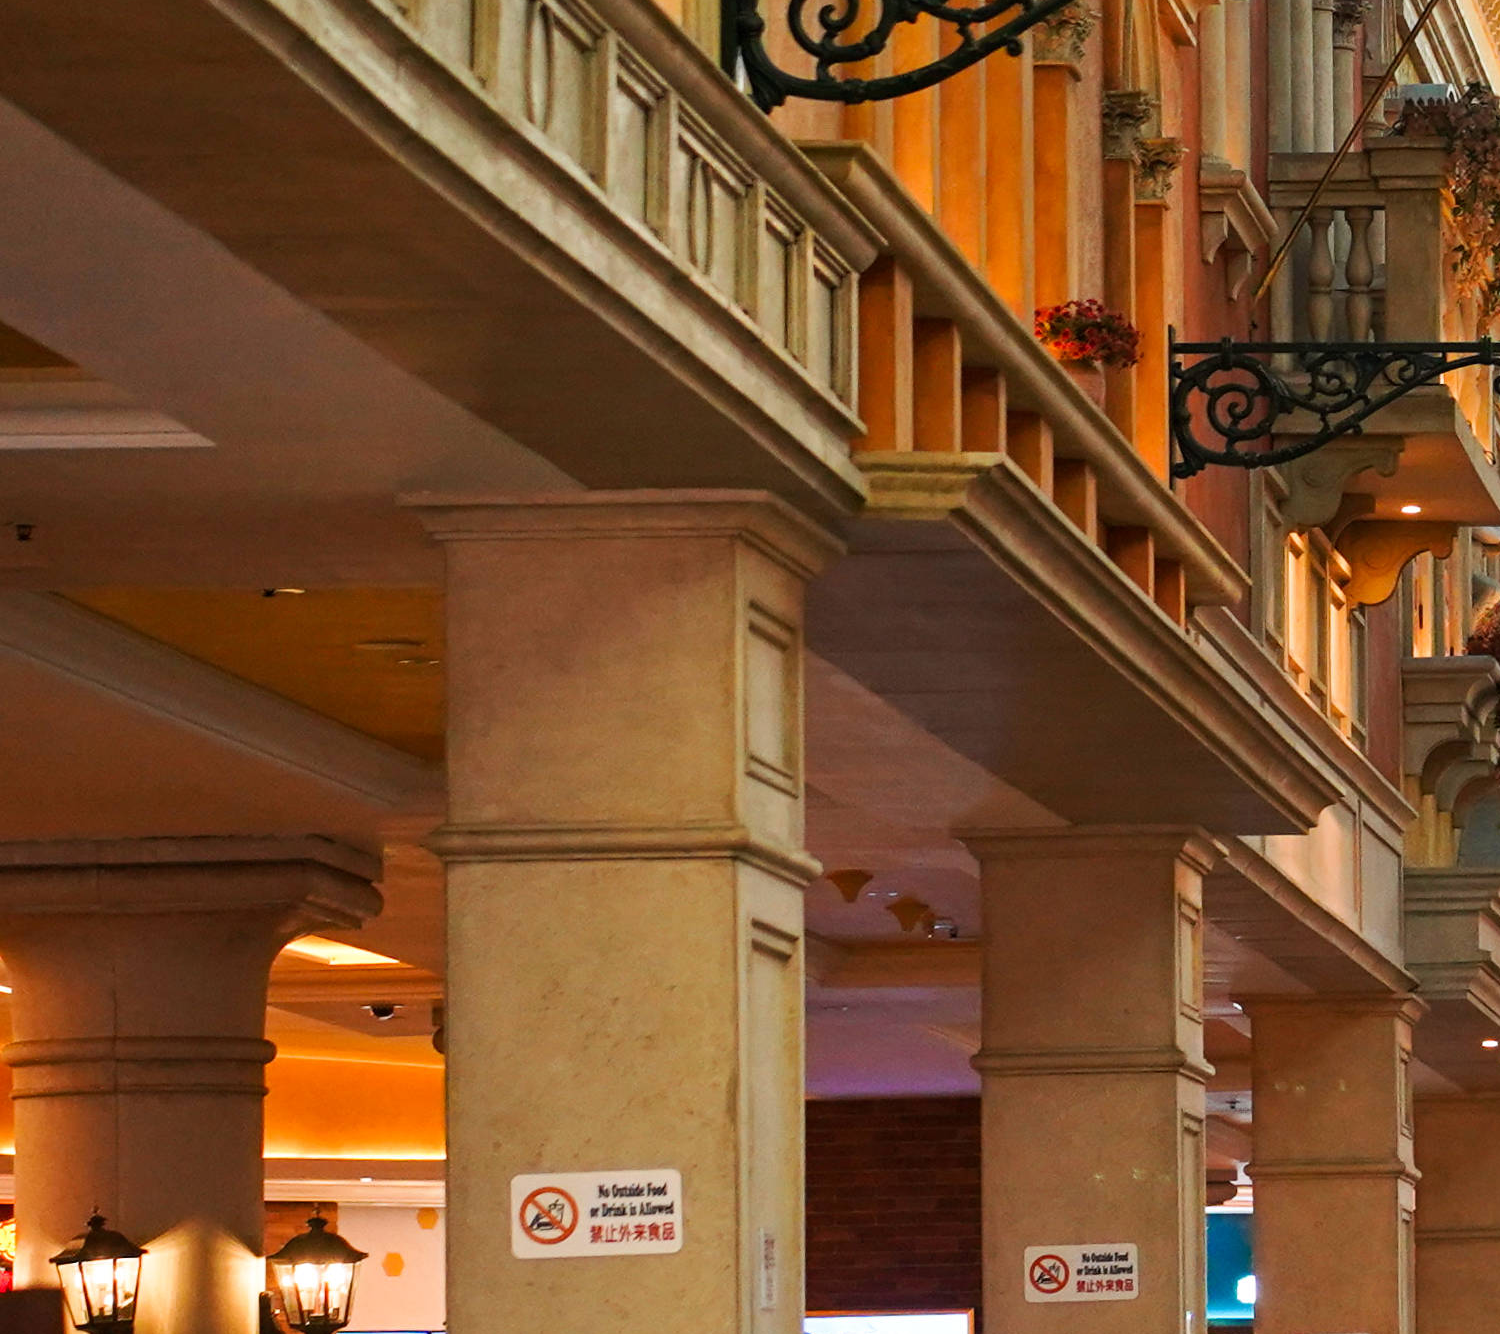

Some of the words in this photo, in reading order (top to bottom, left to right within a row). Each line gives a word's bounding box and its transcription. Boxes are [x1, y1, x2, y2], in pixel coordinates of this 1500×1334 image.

[612, 1183, 645, 1198] Outside
[647, 1182, 668, 1197] Food
[602, 1204, 627, 1217] Drink
[639, 1201, 675, 1215] Allowed
